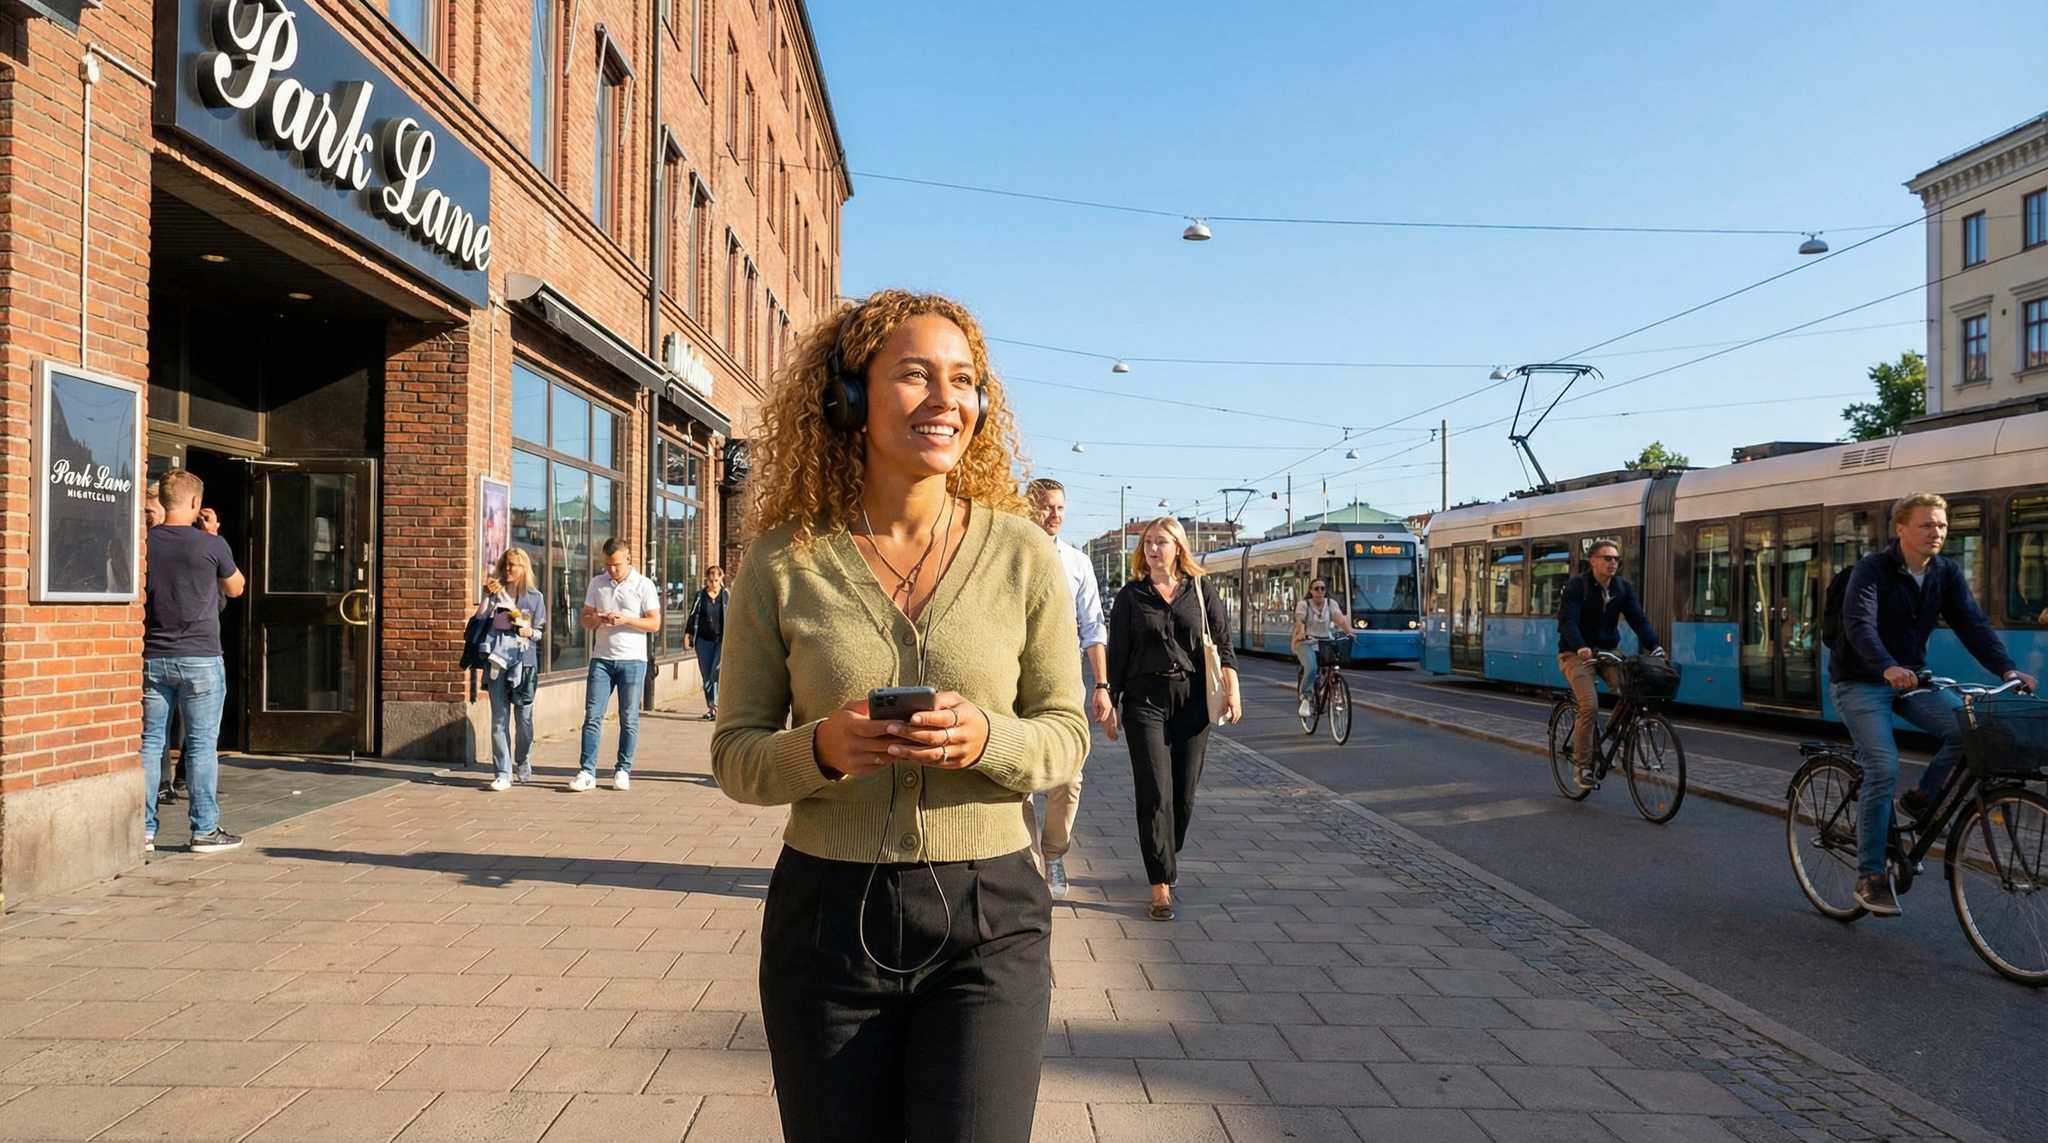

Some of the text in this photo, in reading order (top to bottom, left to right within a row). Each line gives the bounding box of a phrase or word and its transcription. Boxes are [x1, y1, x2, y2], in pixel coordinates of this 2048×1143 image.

[213, 0, 492, 272] Park Lane
[50, 458, 132, 493] Park Lane
